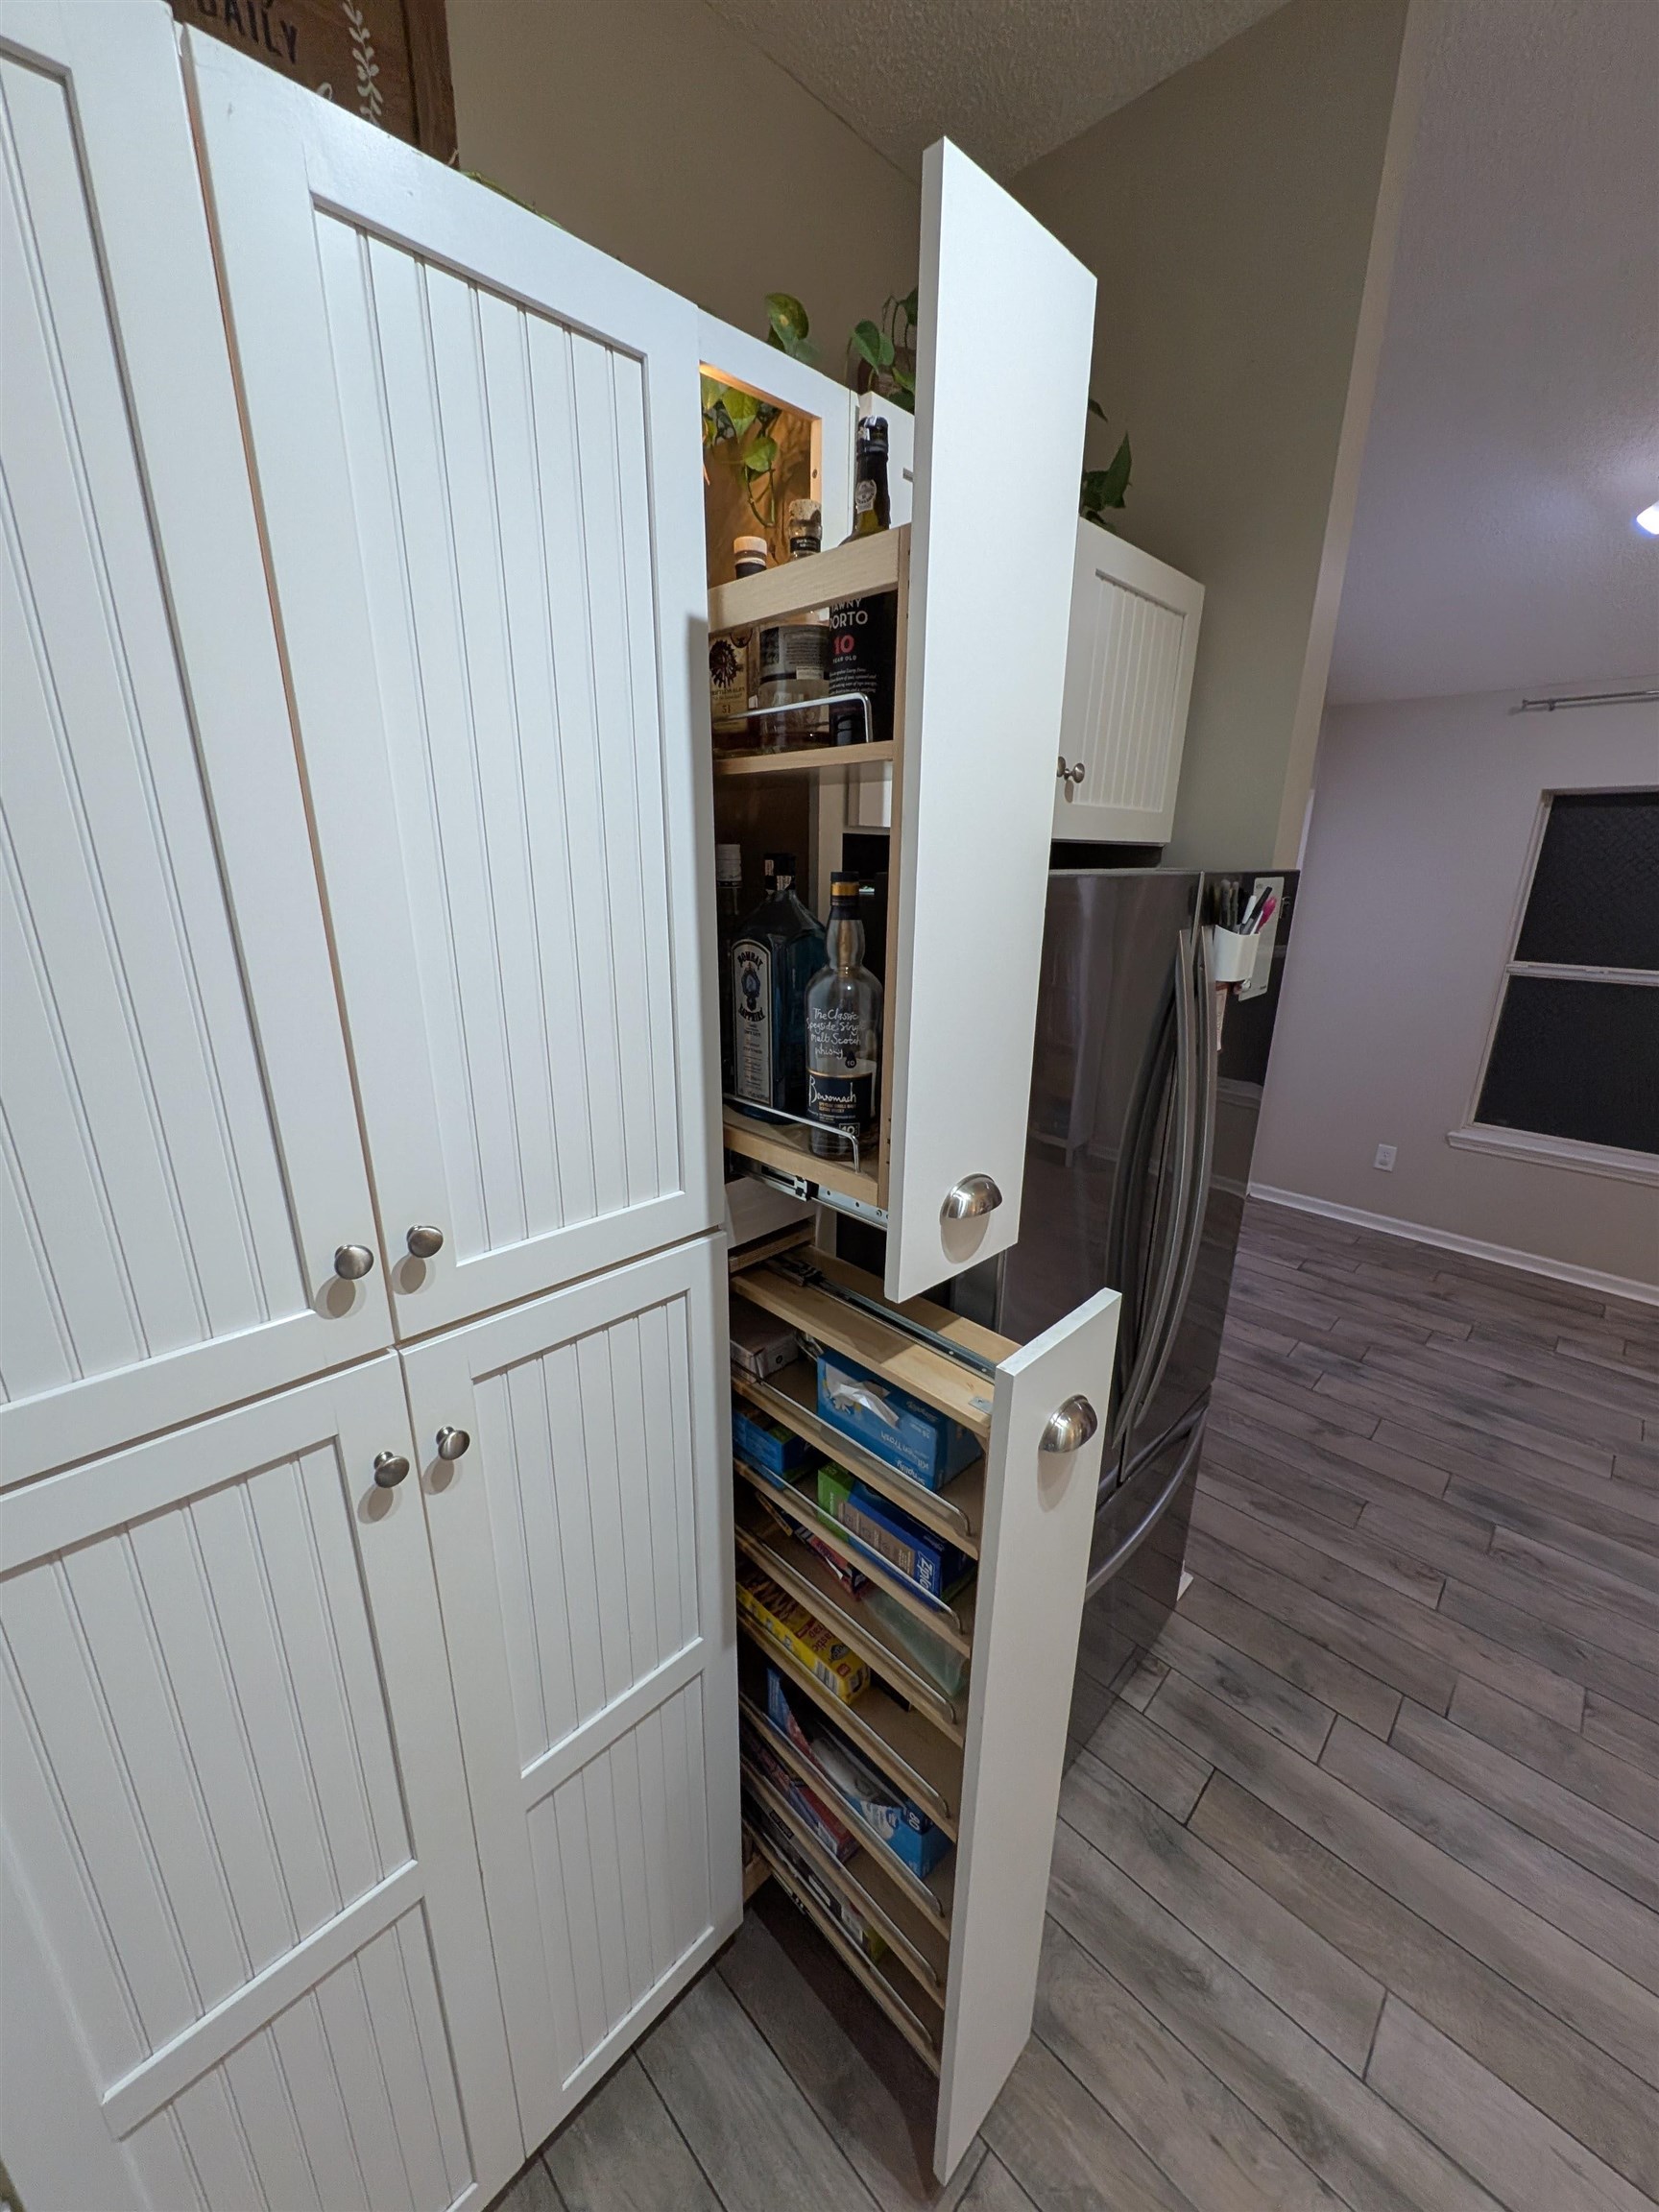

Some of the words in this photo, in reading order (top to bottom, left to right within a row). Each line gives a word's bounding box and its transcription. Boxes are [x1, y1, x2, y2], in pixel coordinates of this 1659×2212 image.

[833, 634, 855, 655] 10
[737, 951, 763, 971] BOMBAY
[738, 1002, 766, 1022] SAPPHIRE
[813, 1007, 827, 1020] The
[828, 1008, 858, 1021] Classic
[806, 1017, 839, 1034] Speyside
[831, 1032, 861, 1046] Scotch
[808, 1074, 857, 1107] Benromach
[880, 1430, 902, 1452] Trash
[916, 1557, 933, 1590] Ziplo
[810, 1629, 836, 1653] lastic
[907, 1812, 921, 1831] 80
